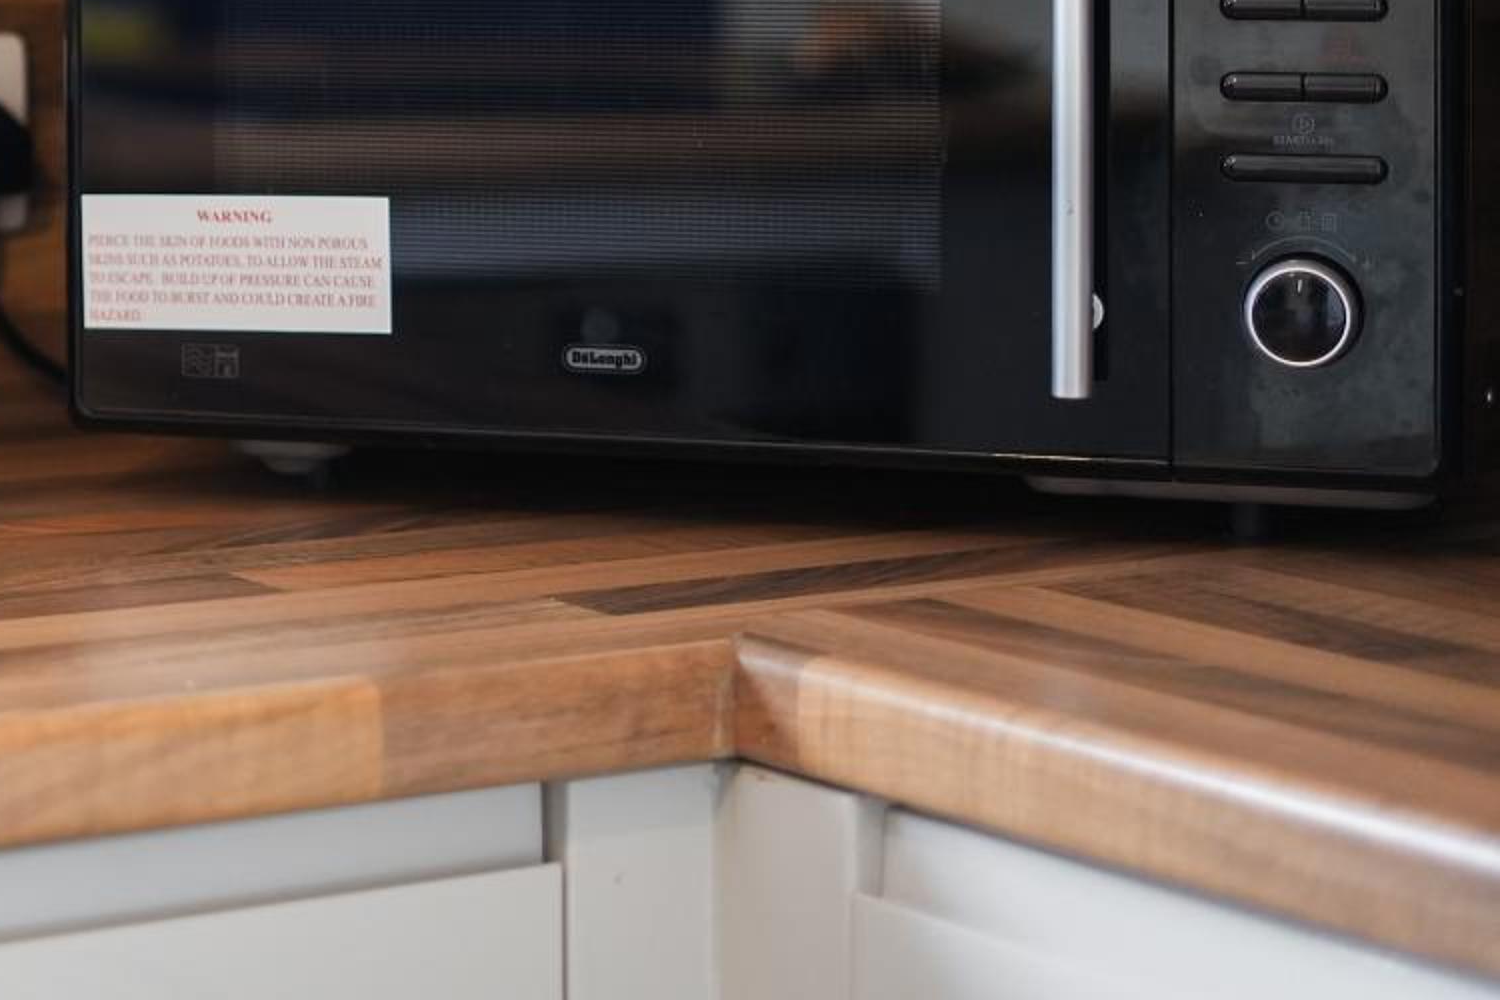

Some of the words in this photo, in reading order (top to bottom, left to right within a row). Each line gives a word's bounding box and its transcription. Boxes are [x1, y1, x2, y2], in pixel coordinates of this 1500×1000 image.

[196, 209, 272, 223] WARNING
[132, 234, 156, 248] THE
[160, 235, 188, 248] SKIN
[190, 236, 206, 249] OF
[254, 236, 285, 249] WITH
[288, 237, 315, 250] NON
[318, 237, 368, 250] POROUS
[162, 254, 178, 267] AS
[246, 255, 263, 267] TO
[265, 255, 309, 268] ALLOW
[311, 256, 337, 269] THE
[340, 256, 382, 269] STEAM
[218, 274, 236, 286] OF
[239, 274, 300, 287] PRESSURE
[303, 275, 331, 288] CAN
[332, 275, 373, 288] CAUSE
[151, 292, 168, 304] TO
[213, 293, 240, 306] AND
[242, 293, 286, 307] COULD
[287, 294, 337, 307] CREATE
[350, 295, 376, 308] FIRE
